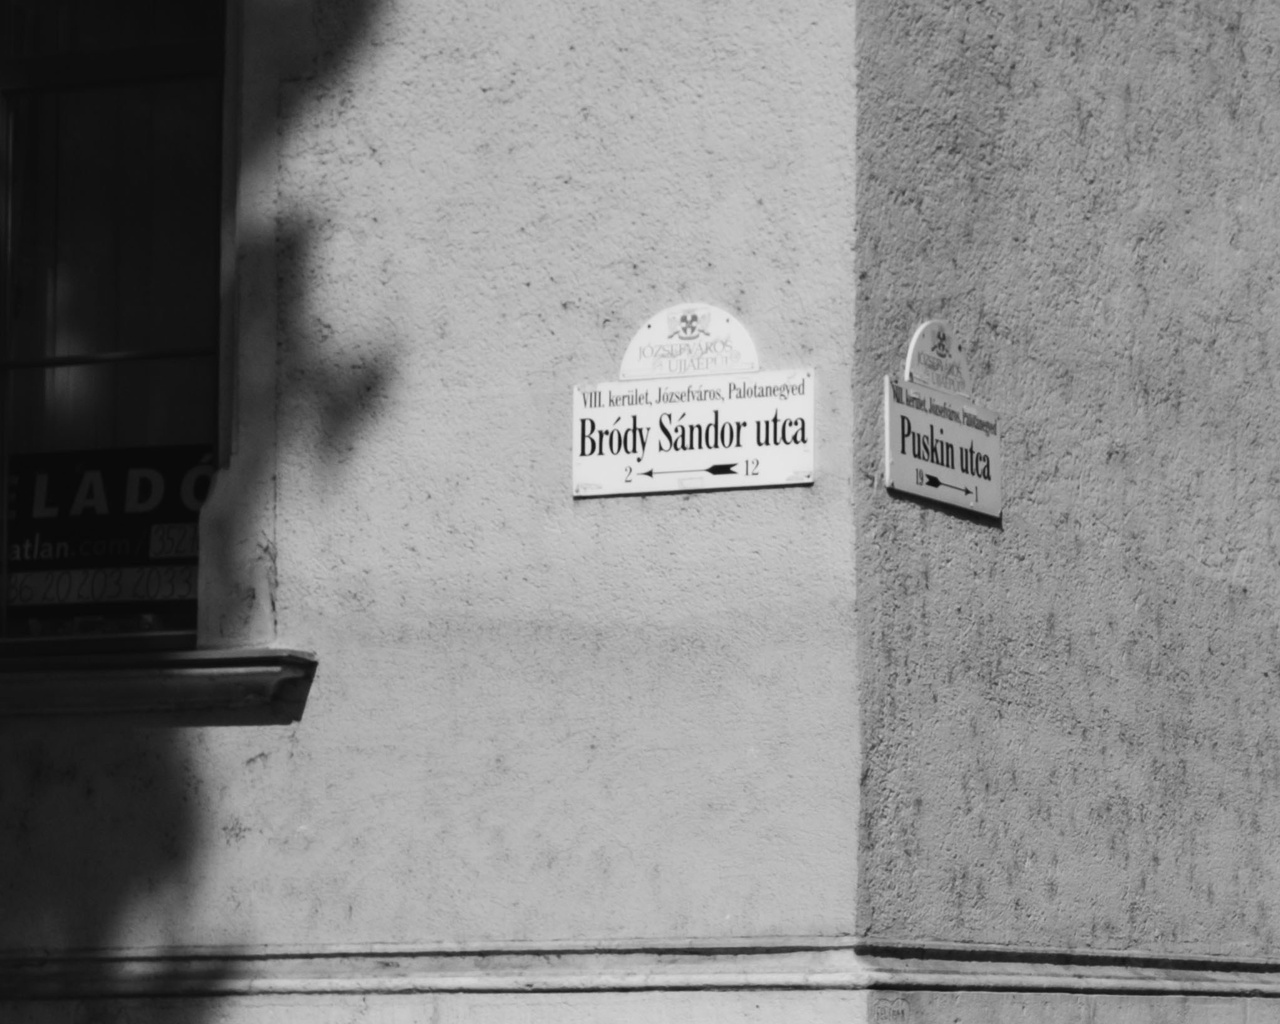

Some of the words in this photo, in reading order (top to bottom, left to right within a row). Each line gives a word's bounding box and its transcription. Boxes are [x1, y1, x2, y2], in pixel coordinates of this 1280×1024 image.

[582, 391, 605, 409] VIII.
[608, 387, 653, 407] kerület,
[655, 383, 724, 406] Józsefváros,
[728, 378, 806, 401] Palotanegyed
[579, 415, 651, 463] Bródy
[658, 408, 747, 453] Sándor
[756, 407, 808, 447] utca
[900, 415, 955, 470] Puskin
[959, 438, 992, 481] utca
[624, 466, 633, 482] 2
[744, 459, 760, 476] 12
[915, 467, 924, 486] 19
[974, 486, 979, 502] 1
